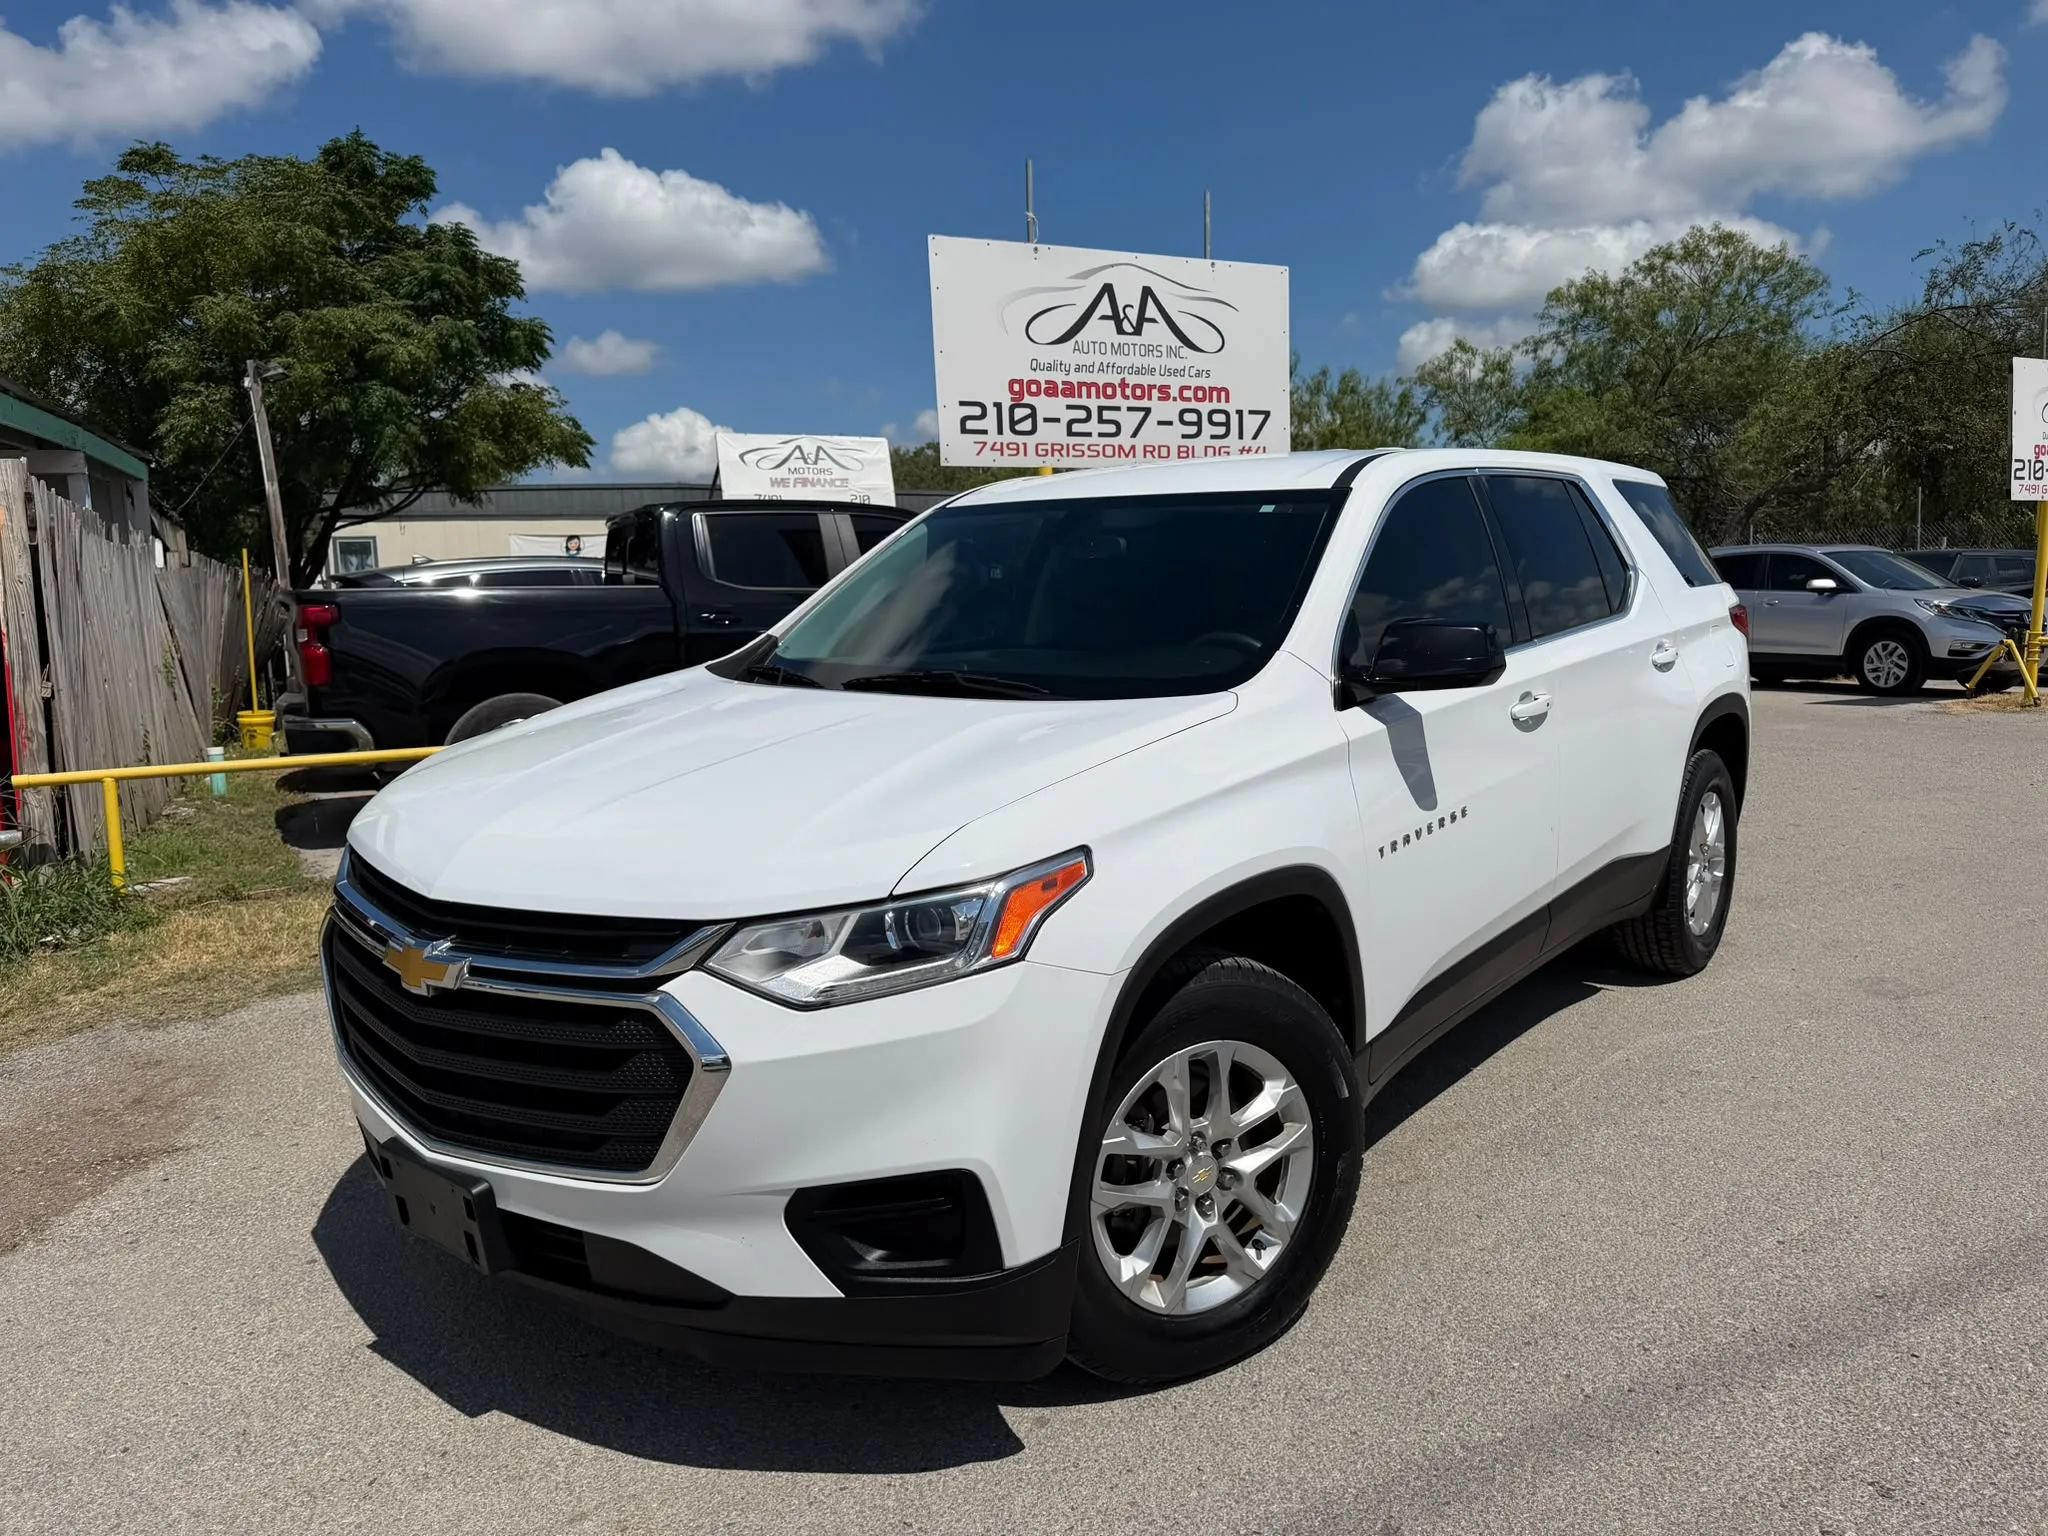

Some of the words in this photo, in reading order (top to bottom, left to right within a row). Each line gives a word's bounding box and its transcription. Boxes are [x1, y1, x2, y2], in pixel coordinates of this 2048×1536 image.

[1072, 340, 1107, 355] AUTO
[1110, 342, 1163, 359] MOTORS
[1166, 345, 1188, 360] INC.
[1030, 358, 1071, 376] Quality
[1074, 361, 1095, 374] and
[1097, 361, 1157, 377] Affordable
[1159, 364, 1186, 378] Used
[1188, 365, 1211, 379] Cars
[1008, 377, 1230, 404] goaamotors.com
[958, 400, 1271, 441] 210-257-9917
[973, 441, 1027, 458] 7491
[1035, 442, 1136, 459] GRISSOM
[1143, 444, 1171, 460] RD
[1177, 445, 1231, 459] BLDG
[788, 467, 833, 476] MOTORS
[769, 477, 791, 488] WE
[793, 477, 849, 488] FINANCE
[2018, 484, 2040, 495] 7491
[1378, 805, 1468, 859] TRAVERSE
